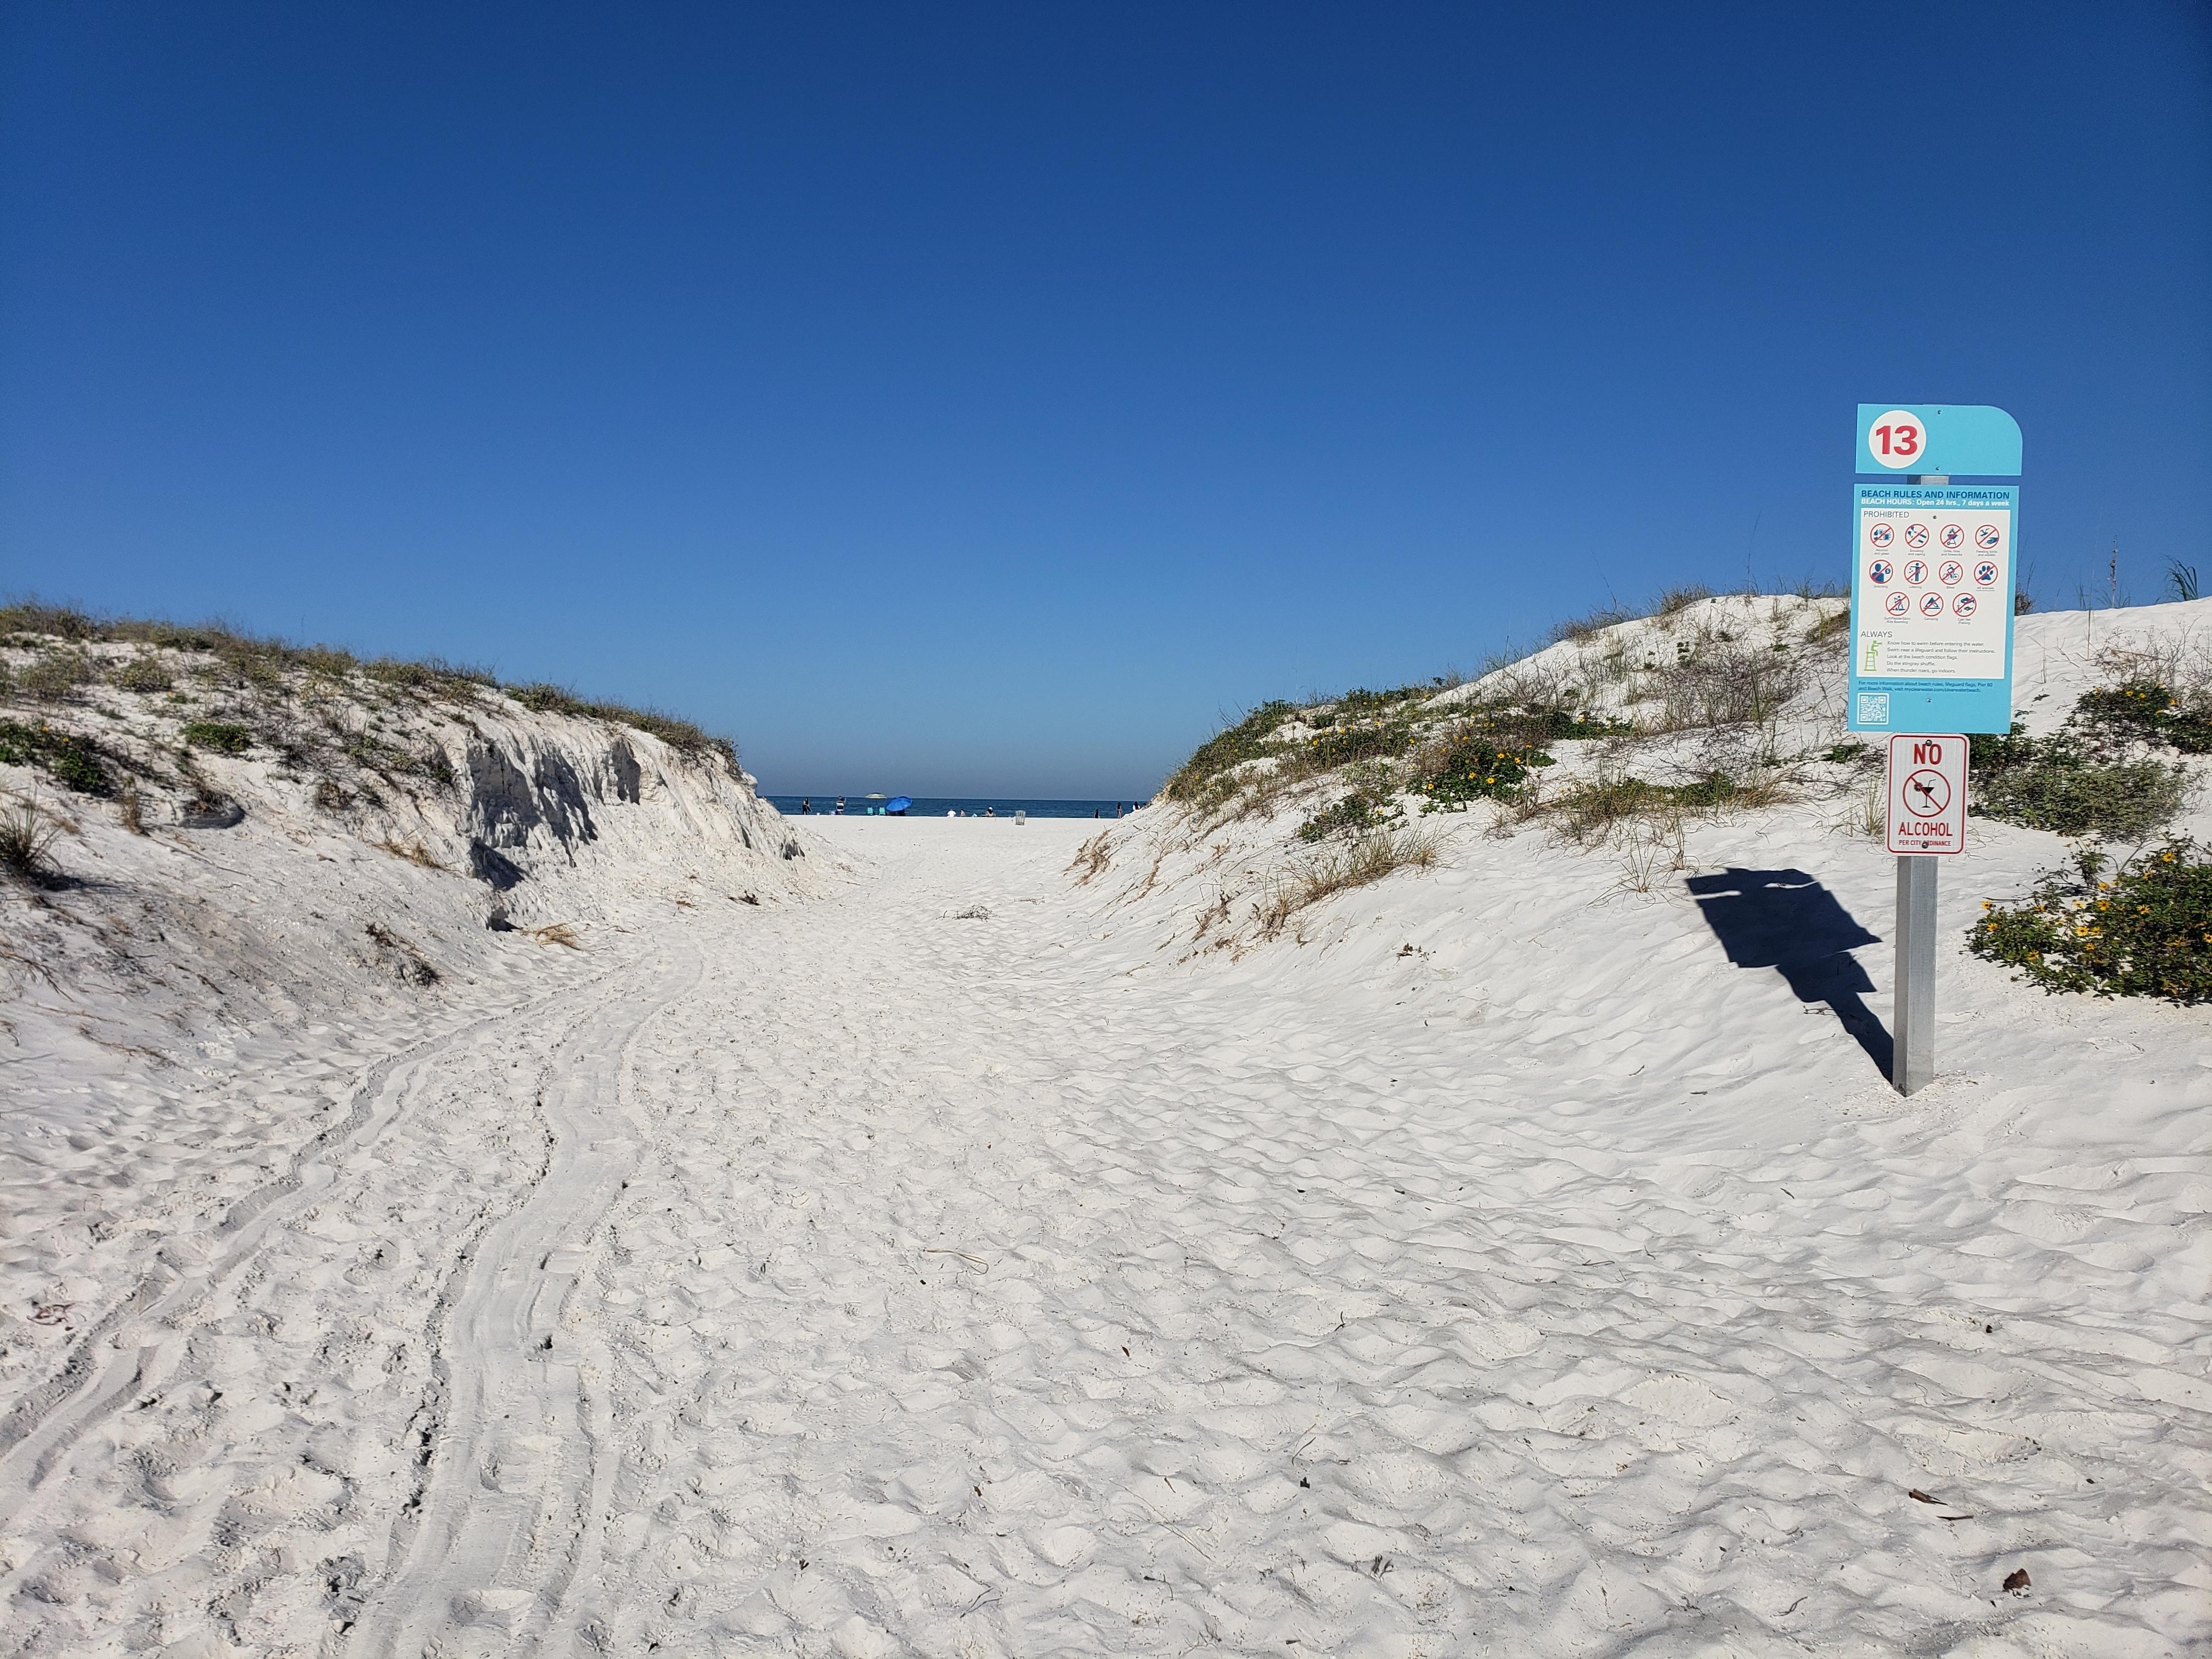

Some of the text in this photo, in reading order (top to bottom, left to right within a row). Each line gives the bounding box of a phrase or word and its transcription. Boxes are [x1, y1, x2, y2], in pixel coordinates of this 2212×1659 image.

[1876, 425, 1918, 455] 13
[1914, 743, 1942, 765] NO
[1899, 822, 1953, 836] ALCOHOL
